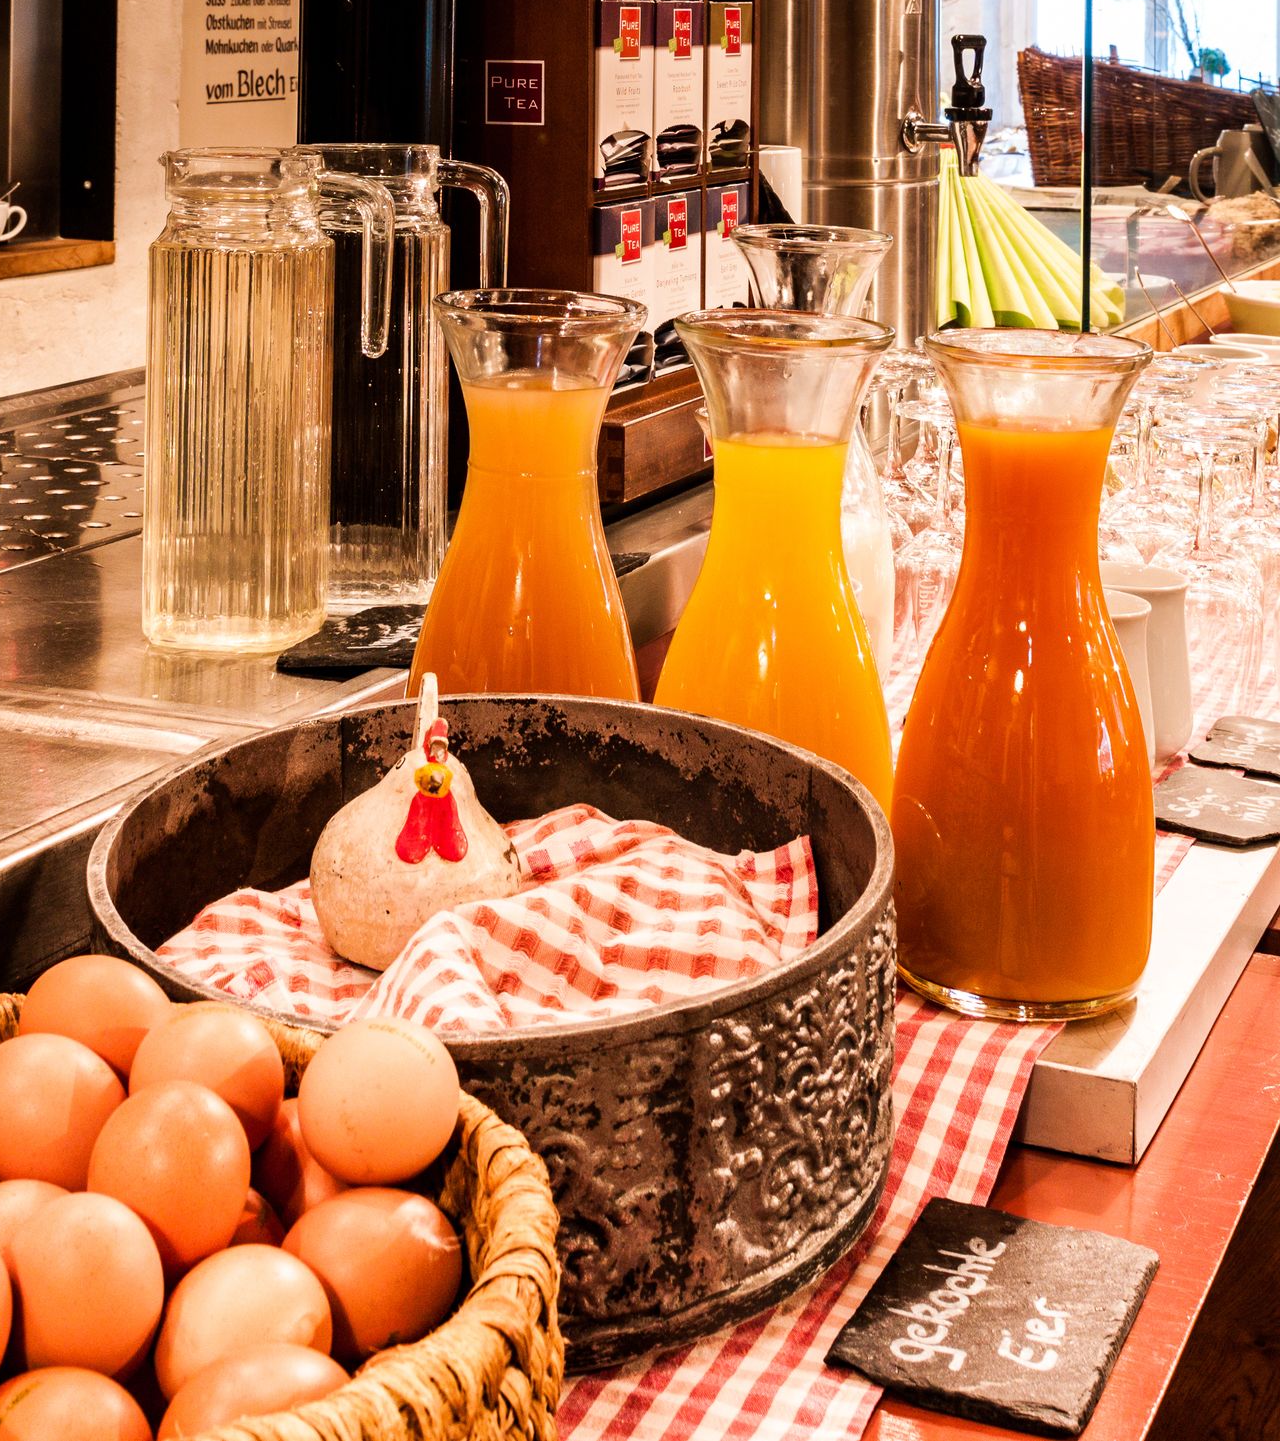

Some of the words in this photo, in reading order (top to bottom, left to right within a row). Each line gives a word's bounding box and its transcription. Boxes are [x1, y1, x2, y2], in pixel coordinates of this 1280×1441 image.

[206, 14, 254, 30] Obstkuchen
[622, 20, 639, 30] PURE
[676, 22, 690, 32] PURE
[726, 20, 740, 29] PURE
[626, 38, 638, 48] TEA
[680, 37, 690, 47] TEA
[730, 36, 740, 45] TEA
[206, 39, 258, 55] Mohnkuchen
[206, 83, 233, 100] vom
[238, 68, 285, 97] Blech
[491, 77, 538, 89] PURE
[504, 97, 538, 109] TEA
[722, 204, 738, 215] PURE
[669, 212, 685, 223] PURE
[726, 217, 738, 228] TEA
[622, 223, 640, 234] PURE
[674, 228, 686, 238] TEA
[628, 240, 640, 251] TEA
[888, 1237, 1006, 1372] gekochte
[998, 1295, 1071, 1371] Eier
